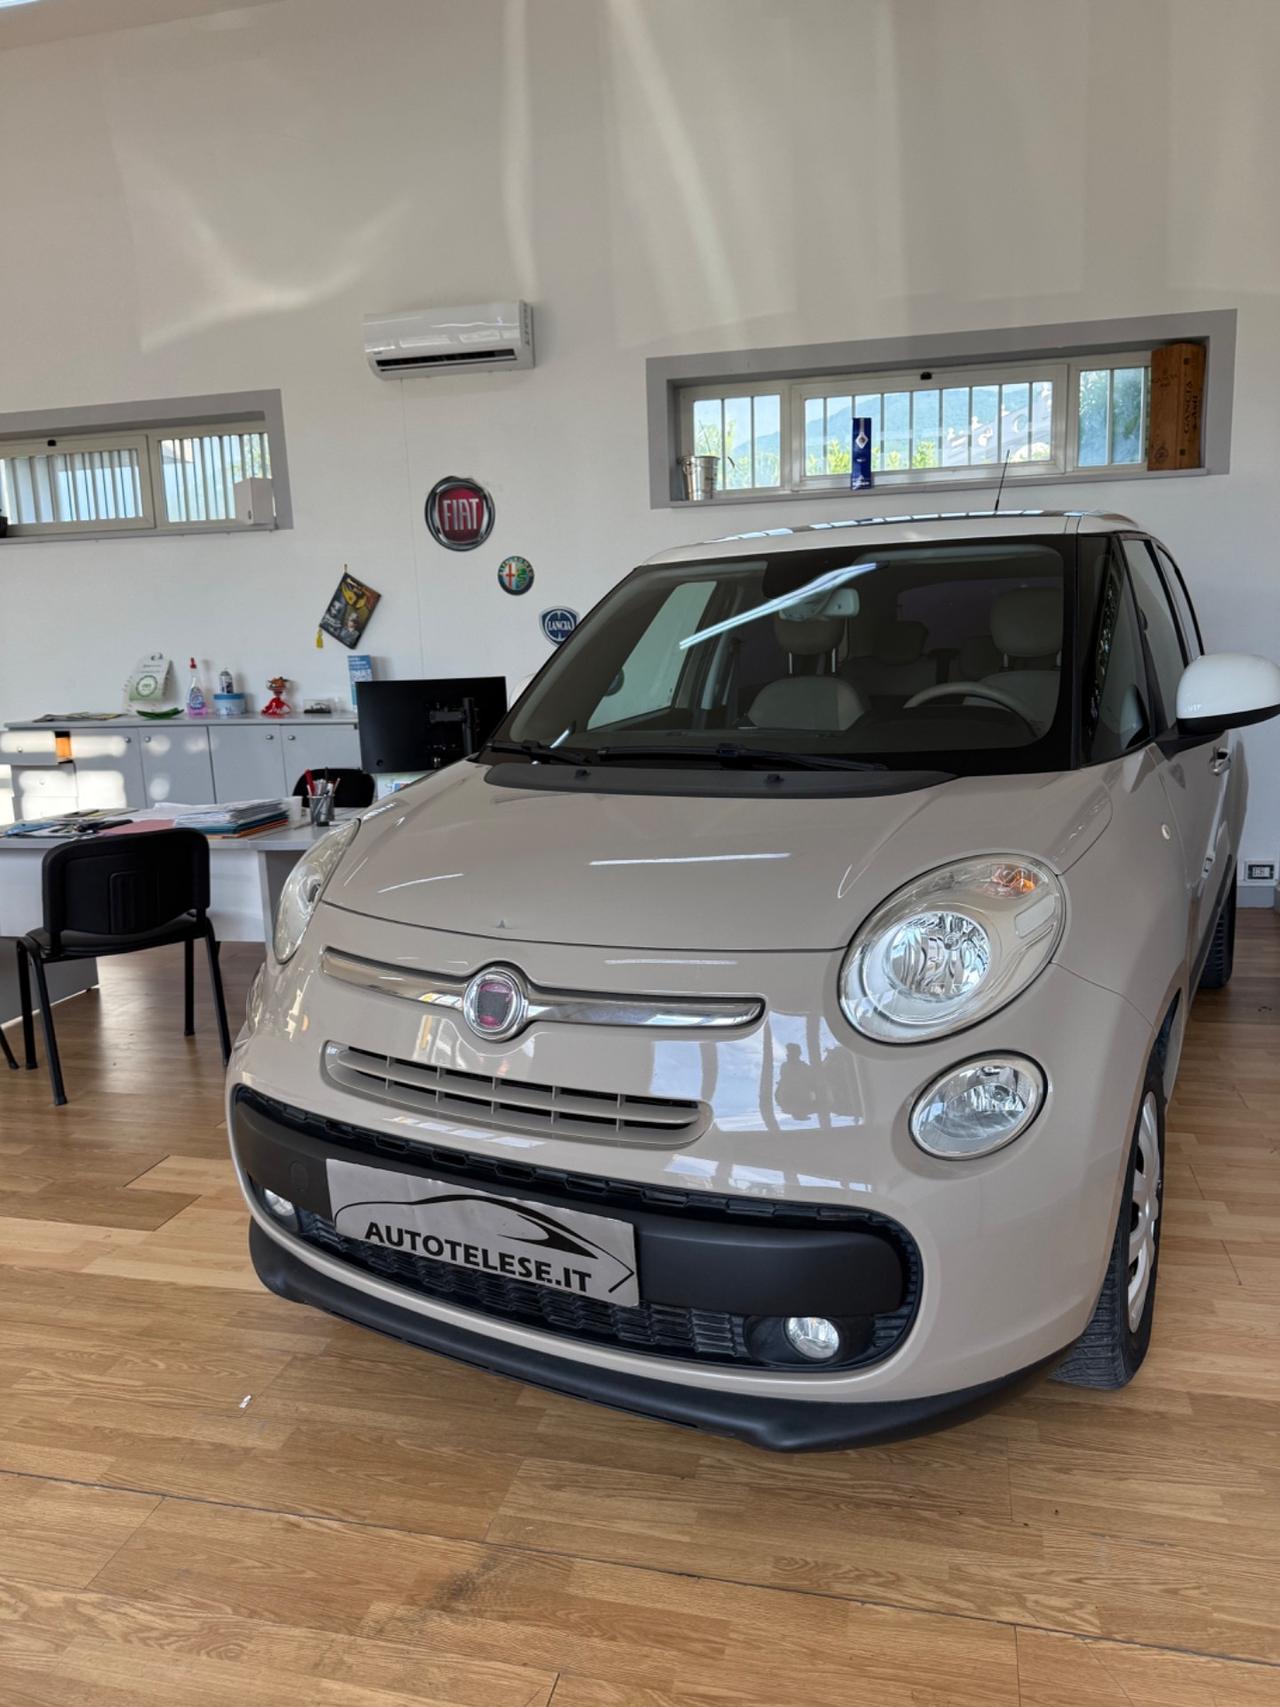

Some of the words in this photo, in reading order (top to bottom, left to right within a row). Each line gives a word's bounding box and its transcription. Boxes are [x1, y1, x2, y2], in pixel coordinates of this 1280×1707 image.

[443, 498, 479, 531] FIAT
[548, 620, 572, 631] LANCIA
[365, 1222, 591, 1292] AUTOTELESE.IT
